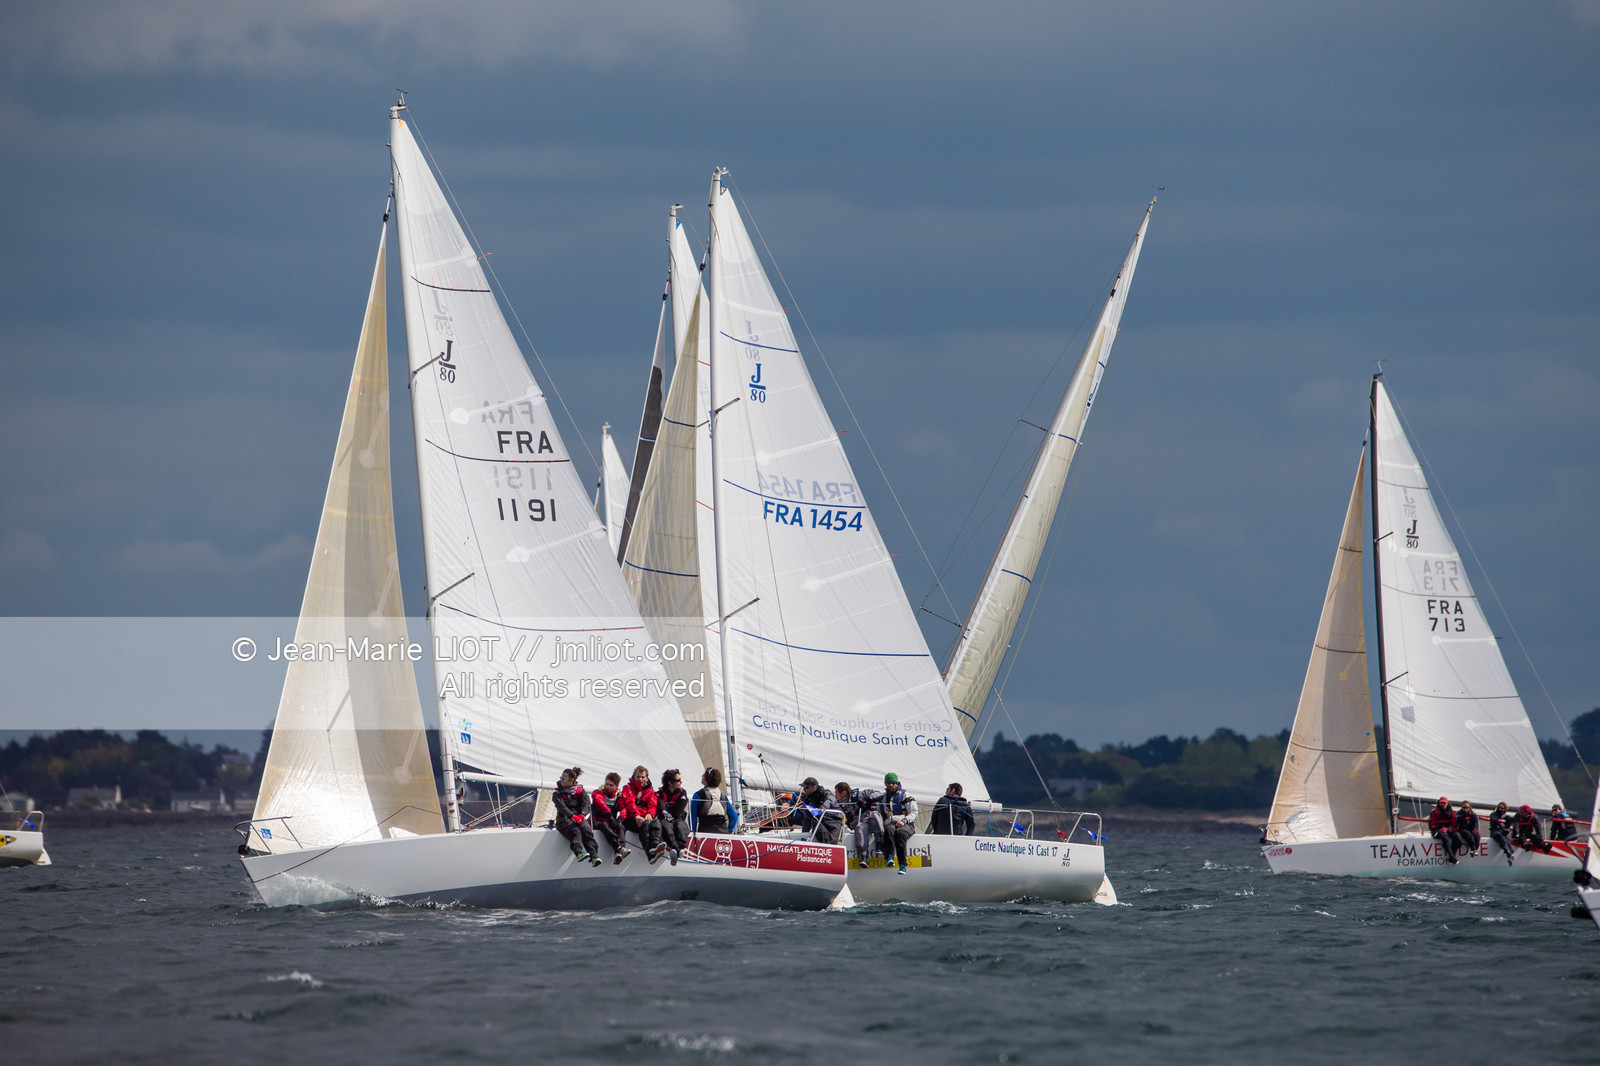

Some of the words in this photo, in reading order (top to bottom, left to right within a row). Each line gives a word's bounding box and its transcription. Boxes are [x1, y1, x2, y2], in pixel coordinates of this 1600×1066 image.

[440, 340, 453, 362] J
[440, 367, 456, 383] 80
[751, 363, 762, 384] J
[750, 389, 766, 403] 80
[497, 431, 554, 454] FRA
[497, 498, 556, 521] 1191
[763, 501, 803, 527] FRA
[810, 509, 863, 532] 1454
[1407, 520, 1417, 535] J
[1406, 539, 1419, 549] 80
[1427, 600, 1463, 615] FRA
[1429, 617, 1466, 632] 713
[752, 715, 797, 734] Centre
[802, 725, 867, 744] Nautique
[873, 733, 908, 746] Saint
[914, 735, 948, 747] Cast
[974, 839, 996, 853] Centre
[998, 842, 1026, 857] Nautique
[1027, 844, 1034, 856] St
[1036, 844, 1049, 857] Cast
[1051, 846, 1058, 857] 17
[1063, 848, 1070, 858] J
[1370, 843, 1417, 858] TEAM
[1421, 843, 1488, 857] VEDE
[797, 854, 832, 864] Plaisancerie
